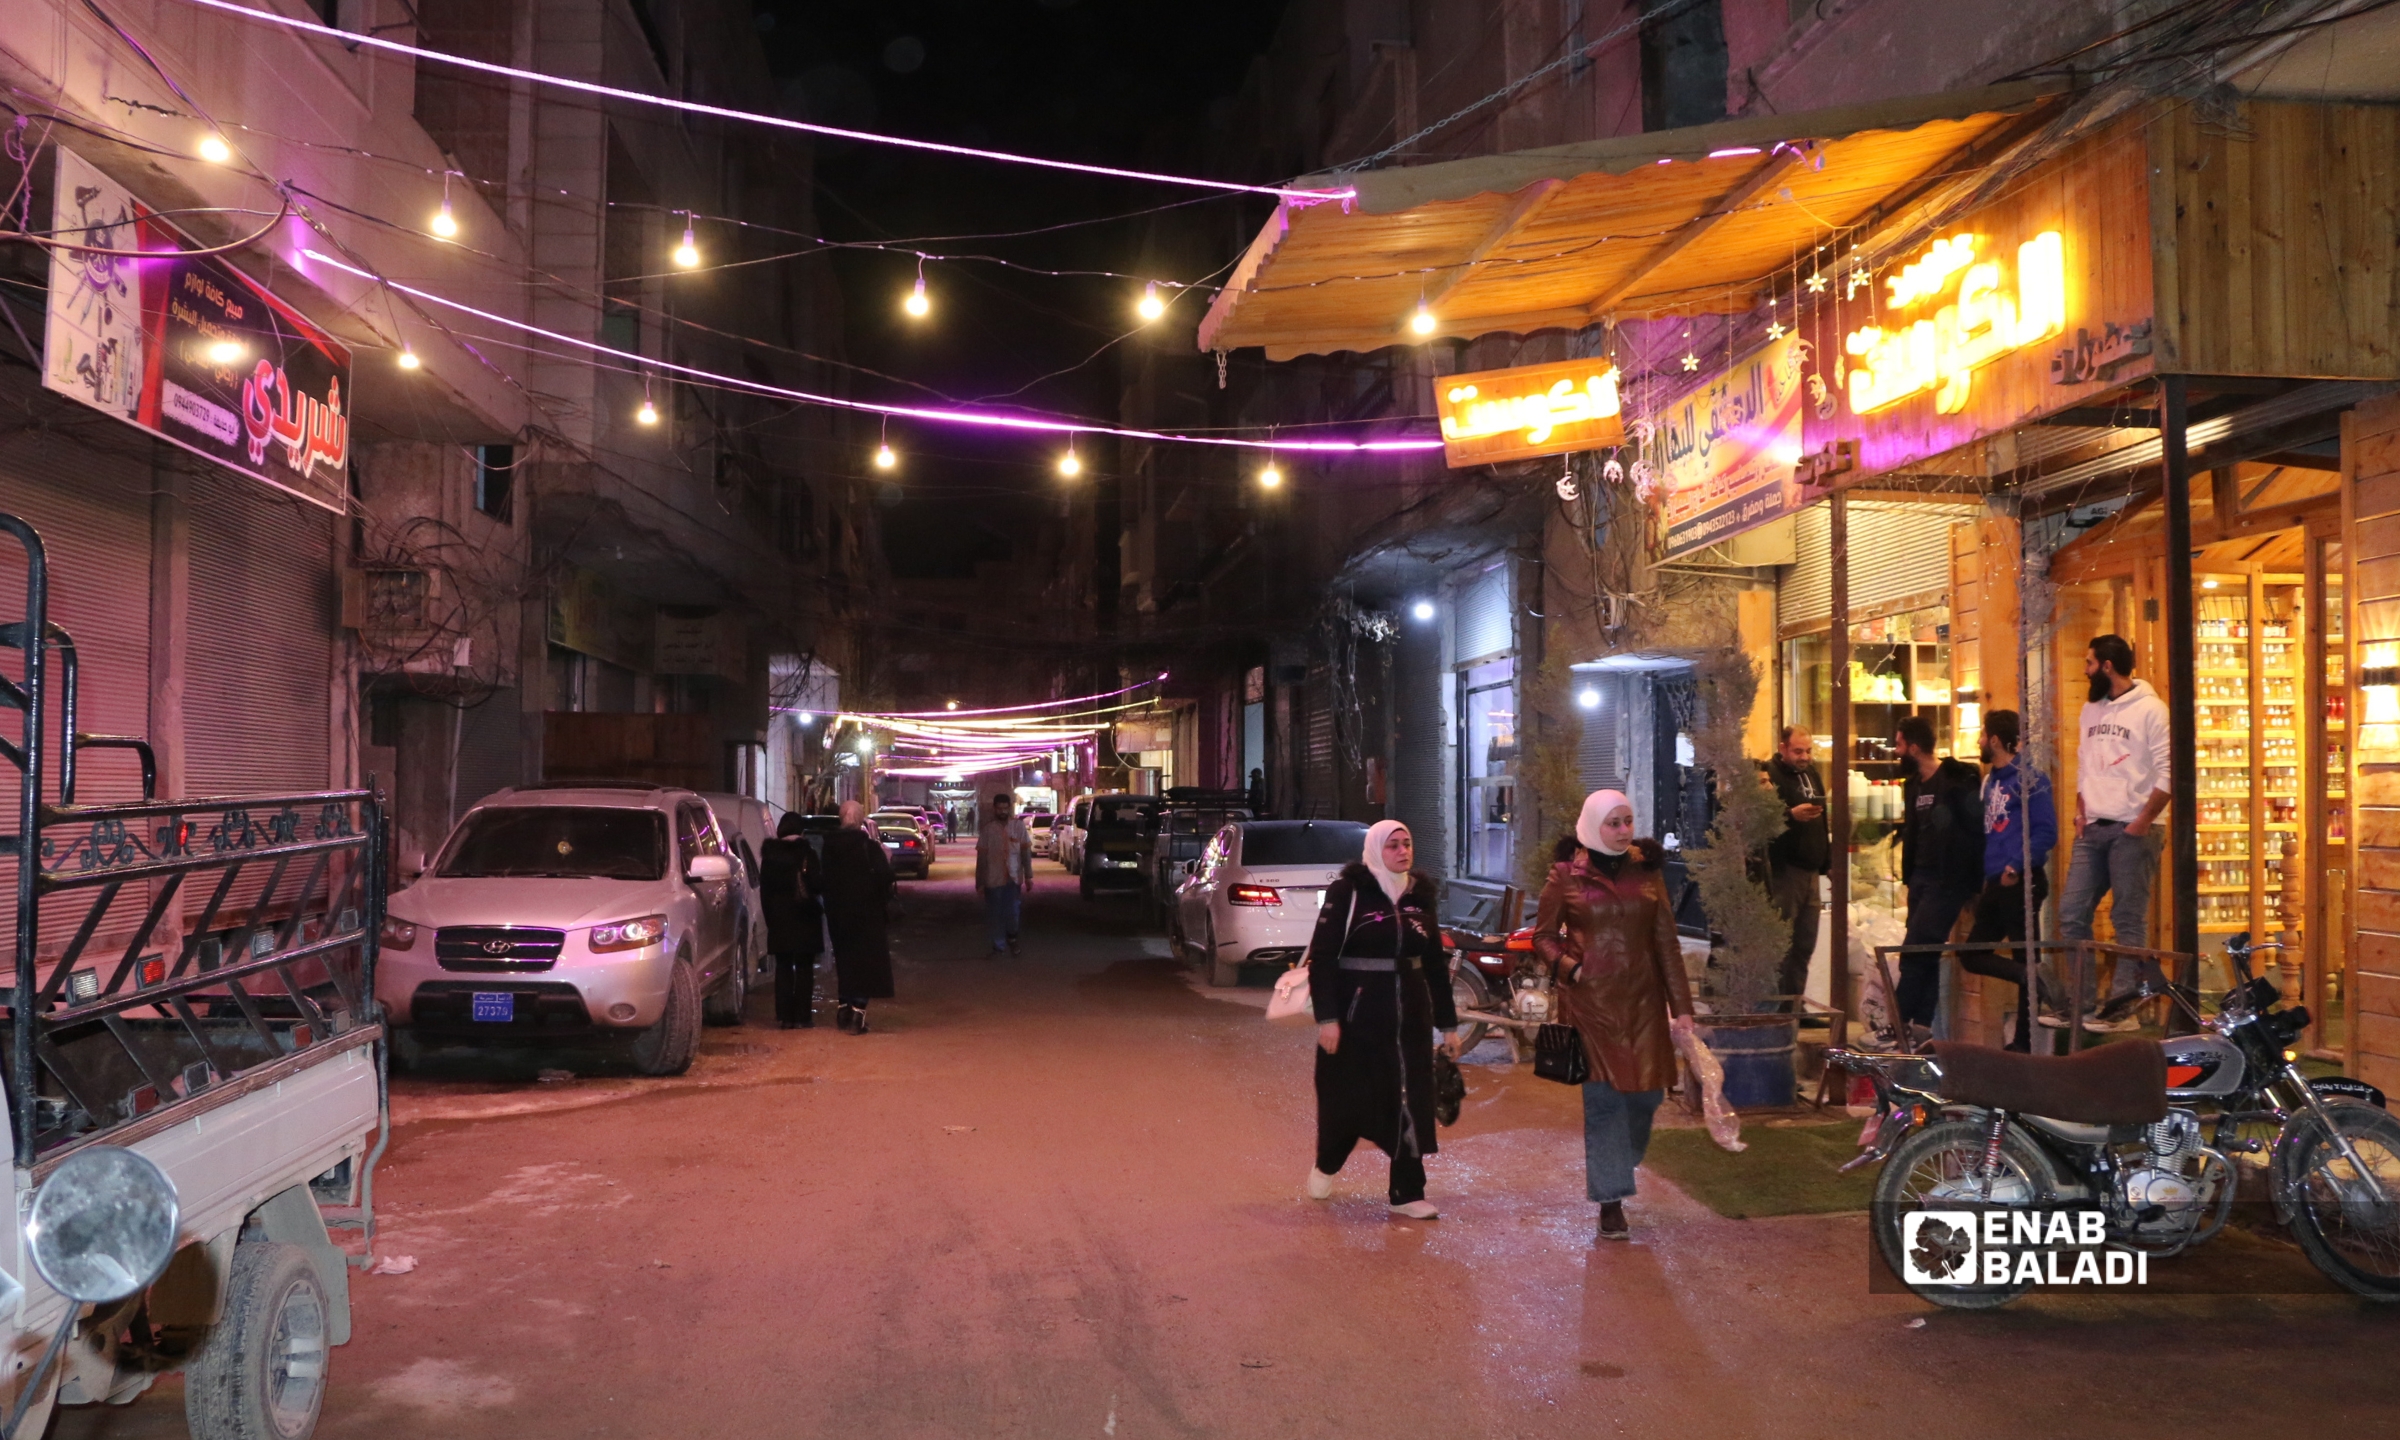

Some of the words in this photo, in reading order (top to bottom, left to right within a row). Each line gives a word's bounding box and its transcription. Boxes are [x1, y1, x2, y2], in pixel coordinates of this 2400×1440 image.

[184, 272, 204, 296] لوازم
[205, 281, 224, 307] كافة
[242, 359, 347, 478] شريدي
